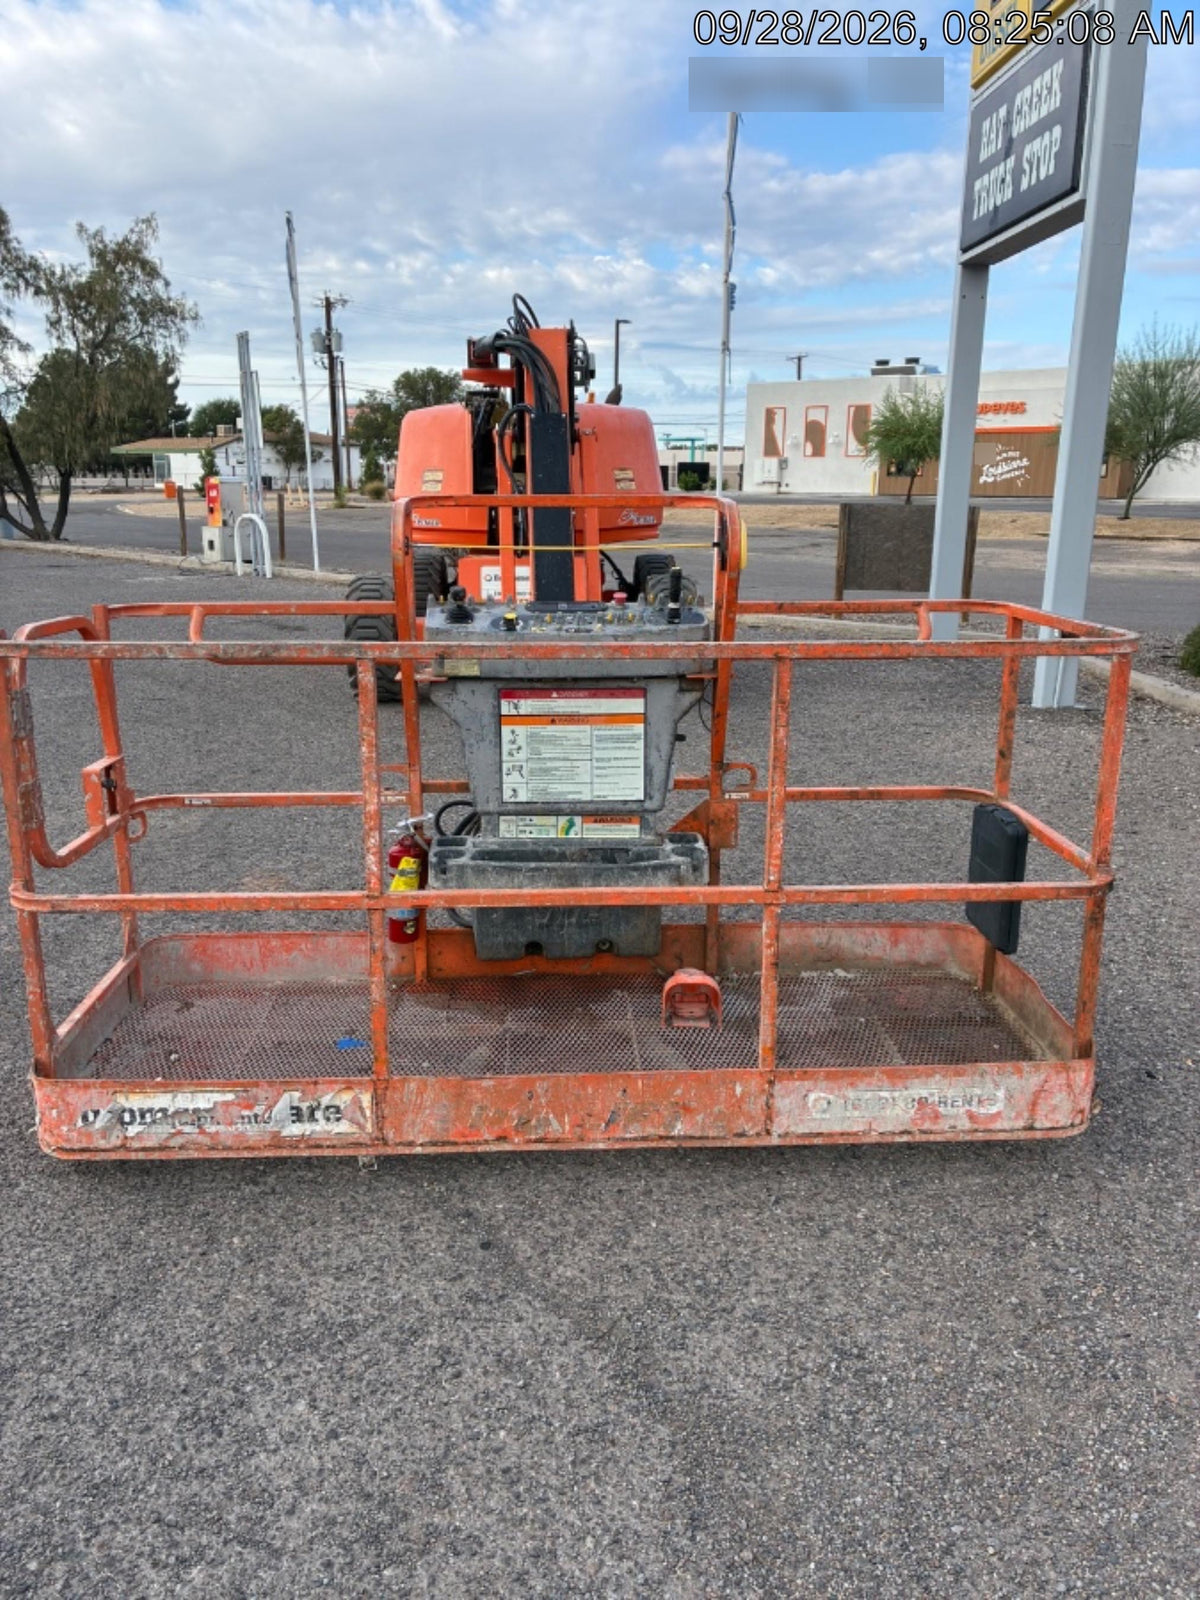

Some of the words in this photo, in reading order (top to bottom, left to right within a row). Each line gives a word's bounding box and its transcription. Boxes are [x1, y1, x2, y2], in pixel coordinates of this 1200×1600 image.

[979, 103, 1007, 163] HAT
[1012, 58, 1065, 139] CREEK
[972, 153, 1016, 221] TRUCK
[1020, 124, 1063, 192] STOP
